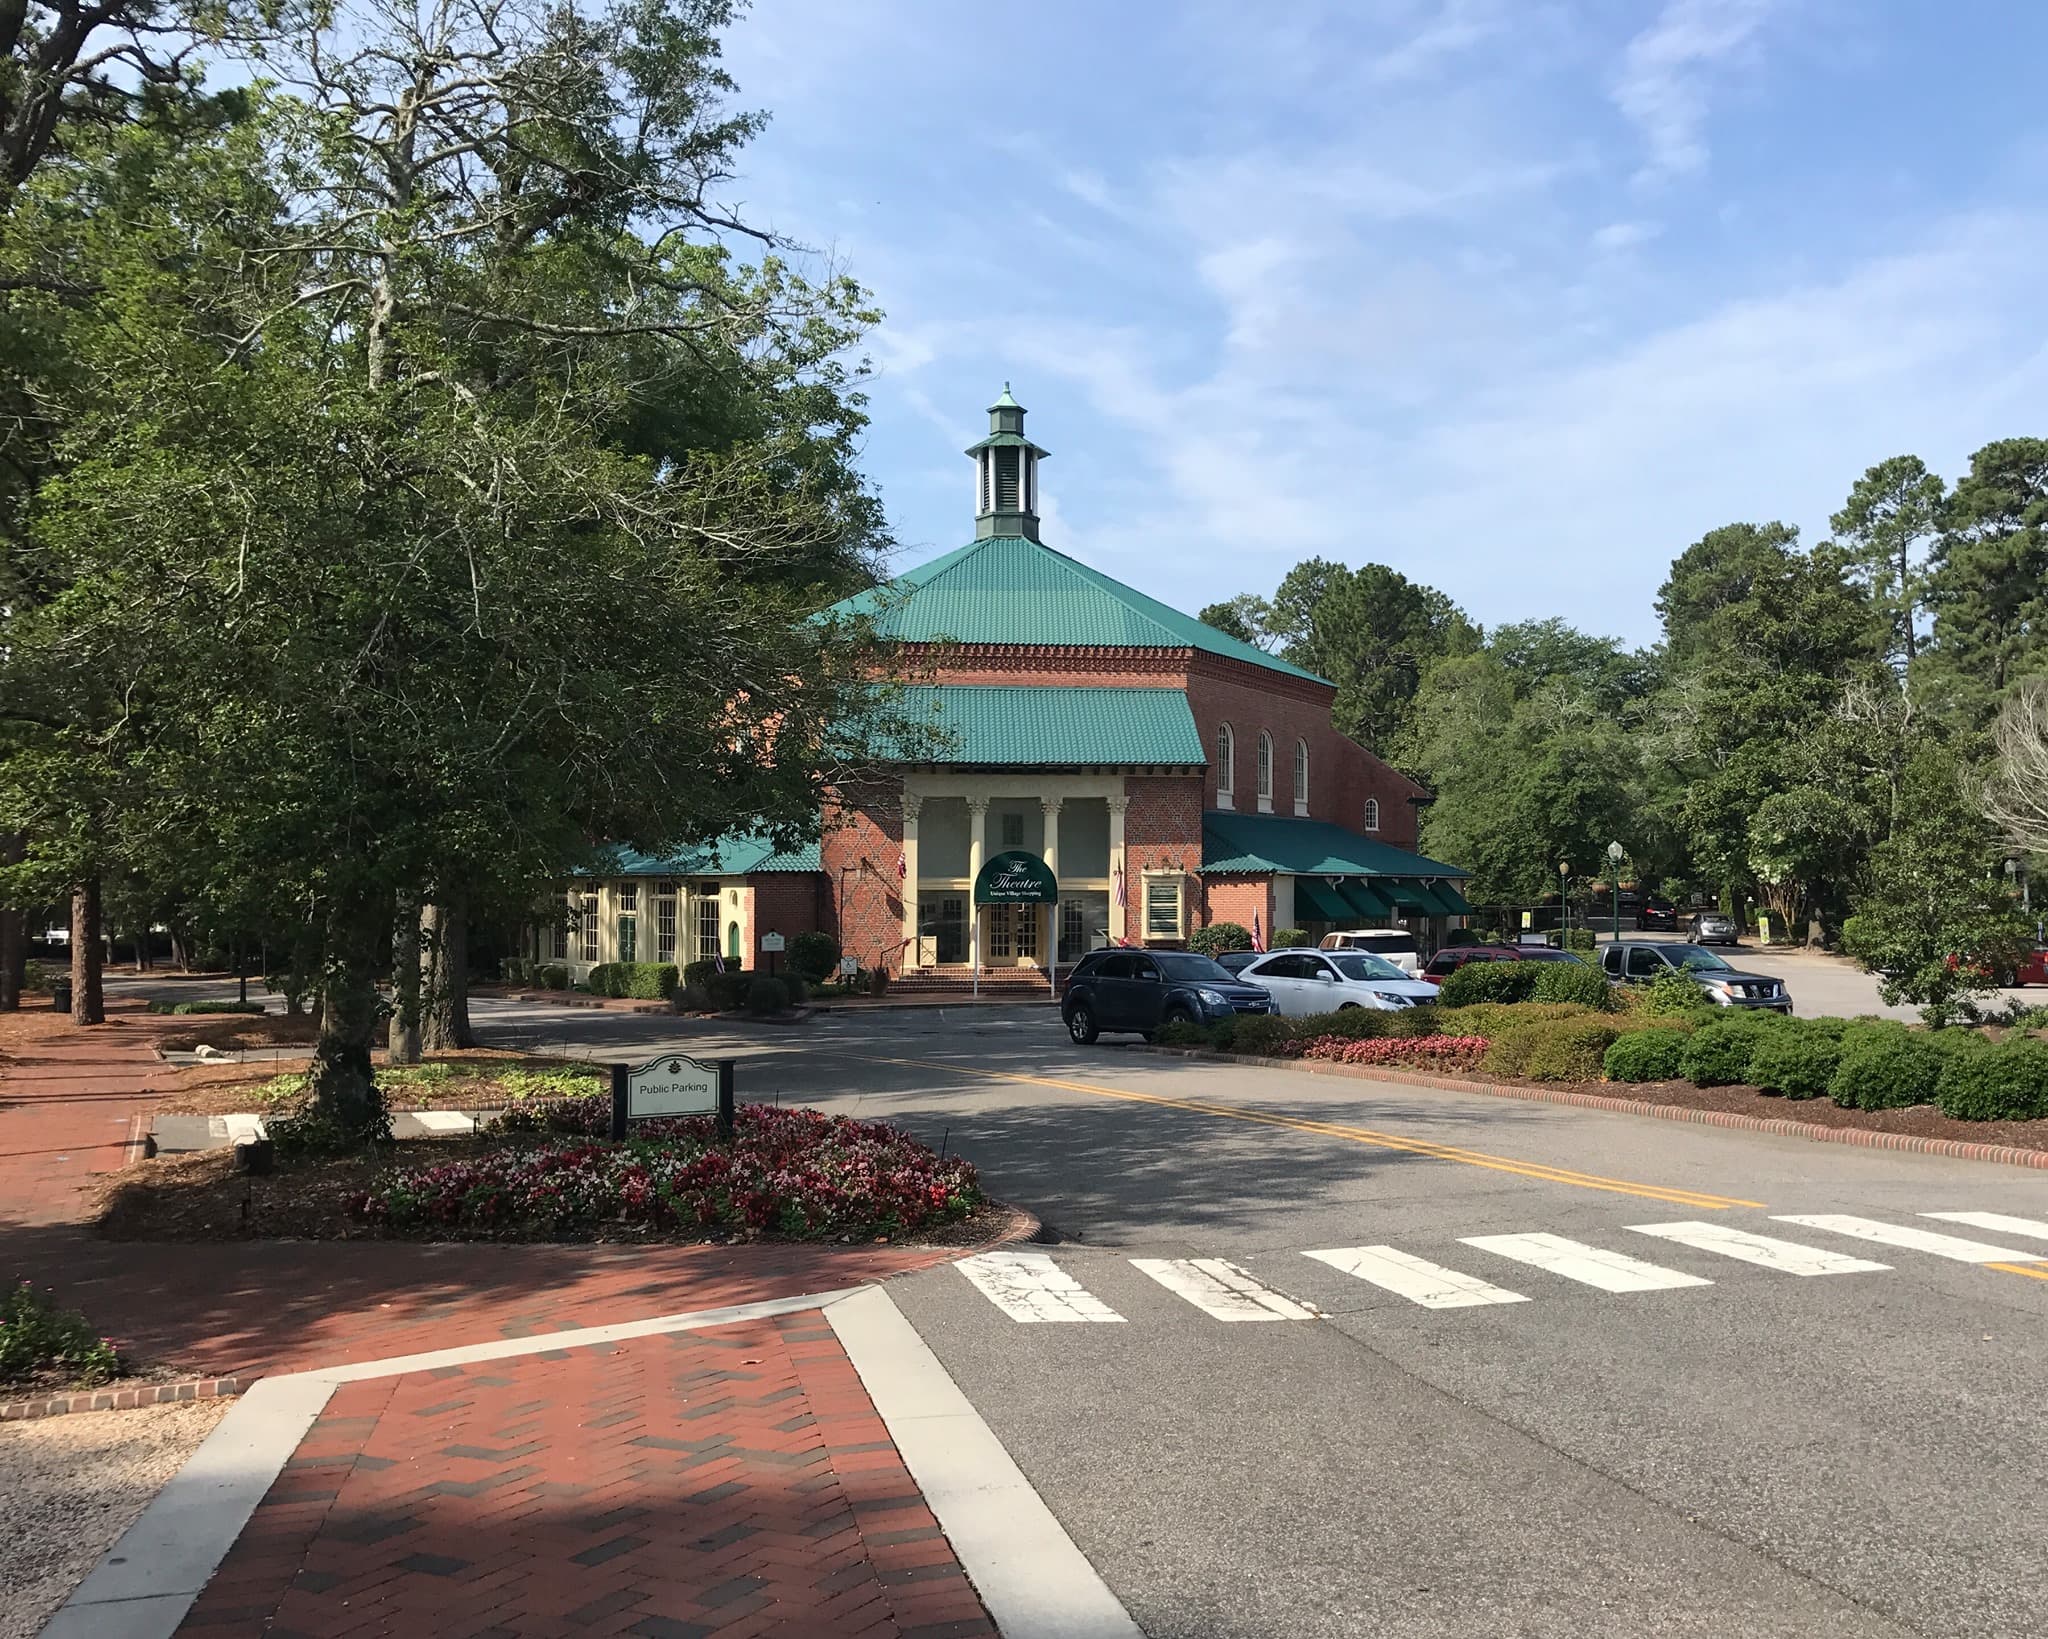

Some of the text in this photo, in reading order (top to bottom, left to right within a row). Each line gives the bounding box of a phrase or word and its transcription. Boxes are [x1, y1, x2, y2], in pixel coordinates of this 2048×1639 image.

[1007, 860, 1028, 873] The
[989, 872, 1042, 889] Theatre
[639, 1083, 708, 1095] Public Parking
